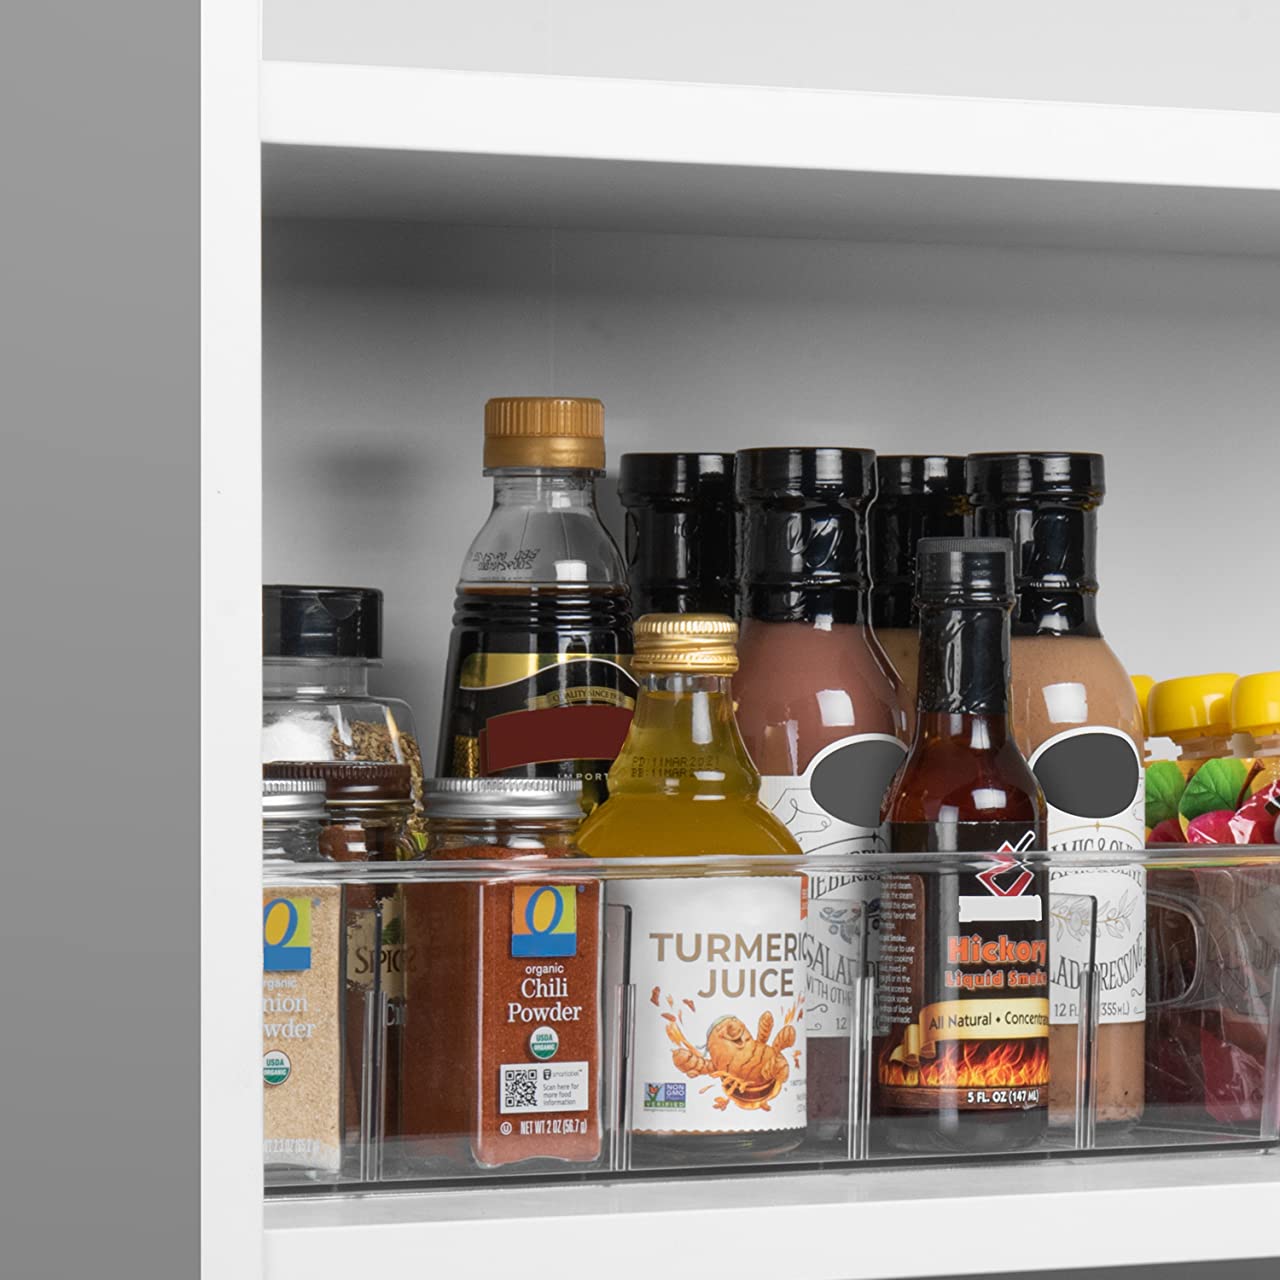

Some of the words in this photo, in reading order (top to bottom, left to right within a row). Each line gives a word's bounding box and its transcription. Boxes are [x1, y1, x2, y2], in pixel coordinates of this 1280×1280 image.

[947, 933, 1047, 966] Hickory
[525, 963, 564, 976] organic
[699, 968, 794, 998] JUICE
[945, 969, 1004, 990] Liquid
[521, 978, 568, 998] Chili
[263, 993, 308, 1012] nion
[1055, 1003, 1067, 1017] 12
[508, 1001, 582, 1023] Powder
[263, 1018, 316, 1038] wder
[836, 1017, 847, 1030] 12
[929, 1016, 943, 1030] All
[948, 1012, 992, 1028] Natural
[536, 1033, 553, 1041] USDA
[266, 1058, 285, 1066] USDA
[543, 1083, 556, 1091] Scan
[967, 1091, 975, 1103] 5
[977, 1091, 990, 1103] FL.
[992, 1090, 1007, 1103] OZ
[1008, 1090, 1028, 1104] (147
[521, 1121, 533, 1135] NET
[535, 1121, 545, 1134] WT
[546, 1120, 551, 1134] 2
